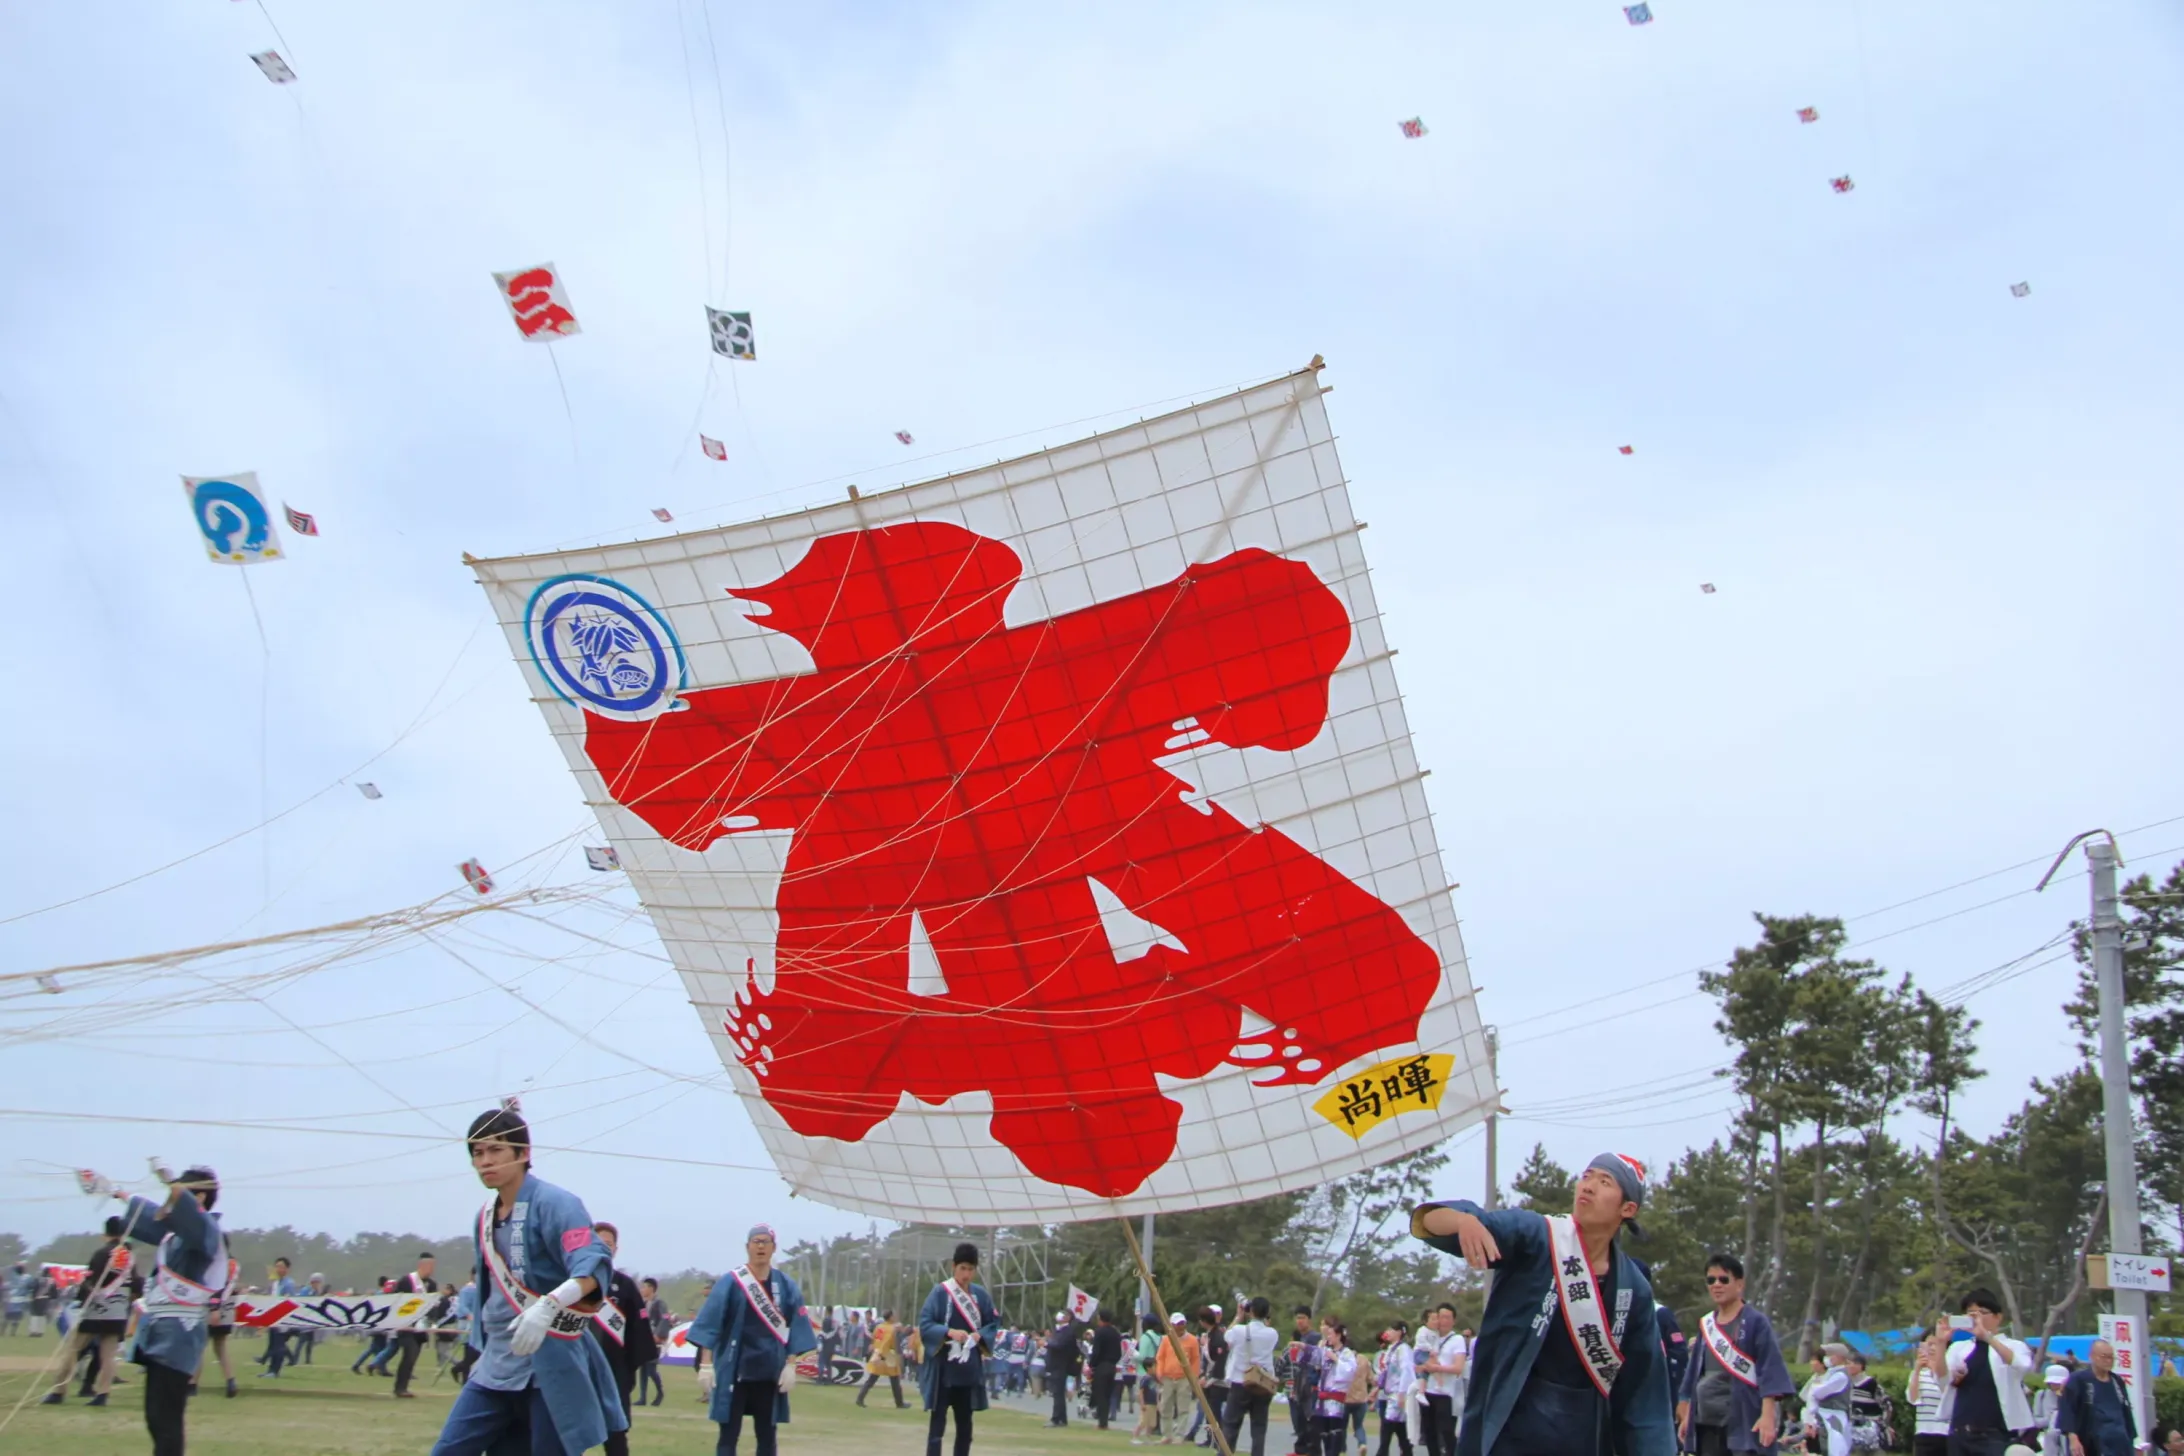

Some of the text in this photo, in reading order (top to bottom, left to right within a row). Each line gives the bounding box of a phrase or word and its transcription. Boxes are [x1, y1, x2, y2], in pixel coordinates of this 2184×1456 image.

[1338, 1055, 1438, 1125] 尚暉
[2113, 1257, 2147, 1270] トイレ
[2114, 1272, 2148, 1285] Toilet
[1562, 1255, 1591, 1303] 本組
